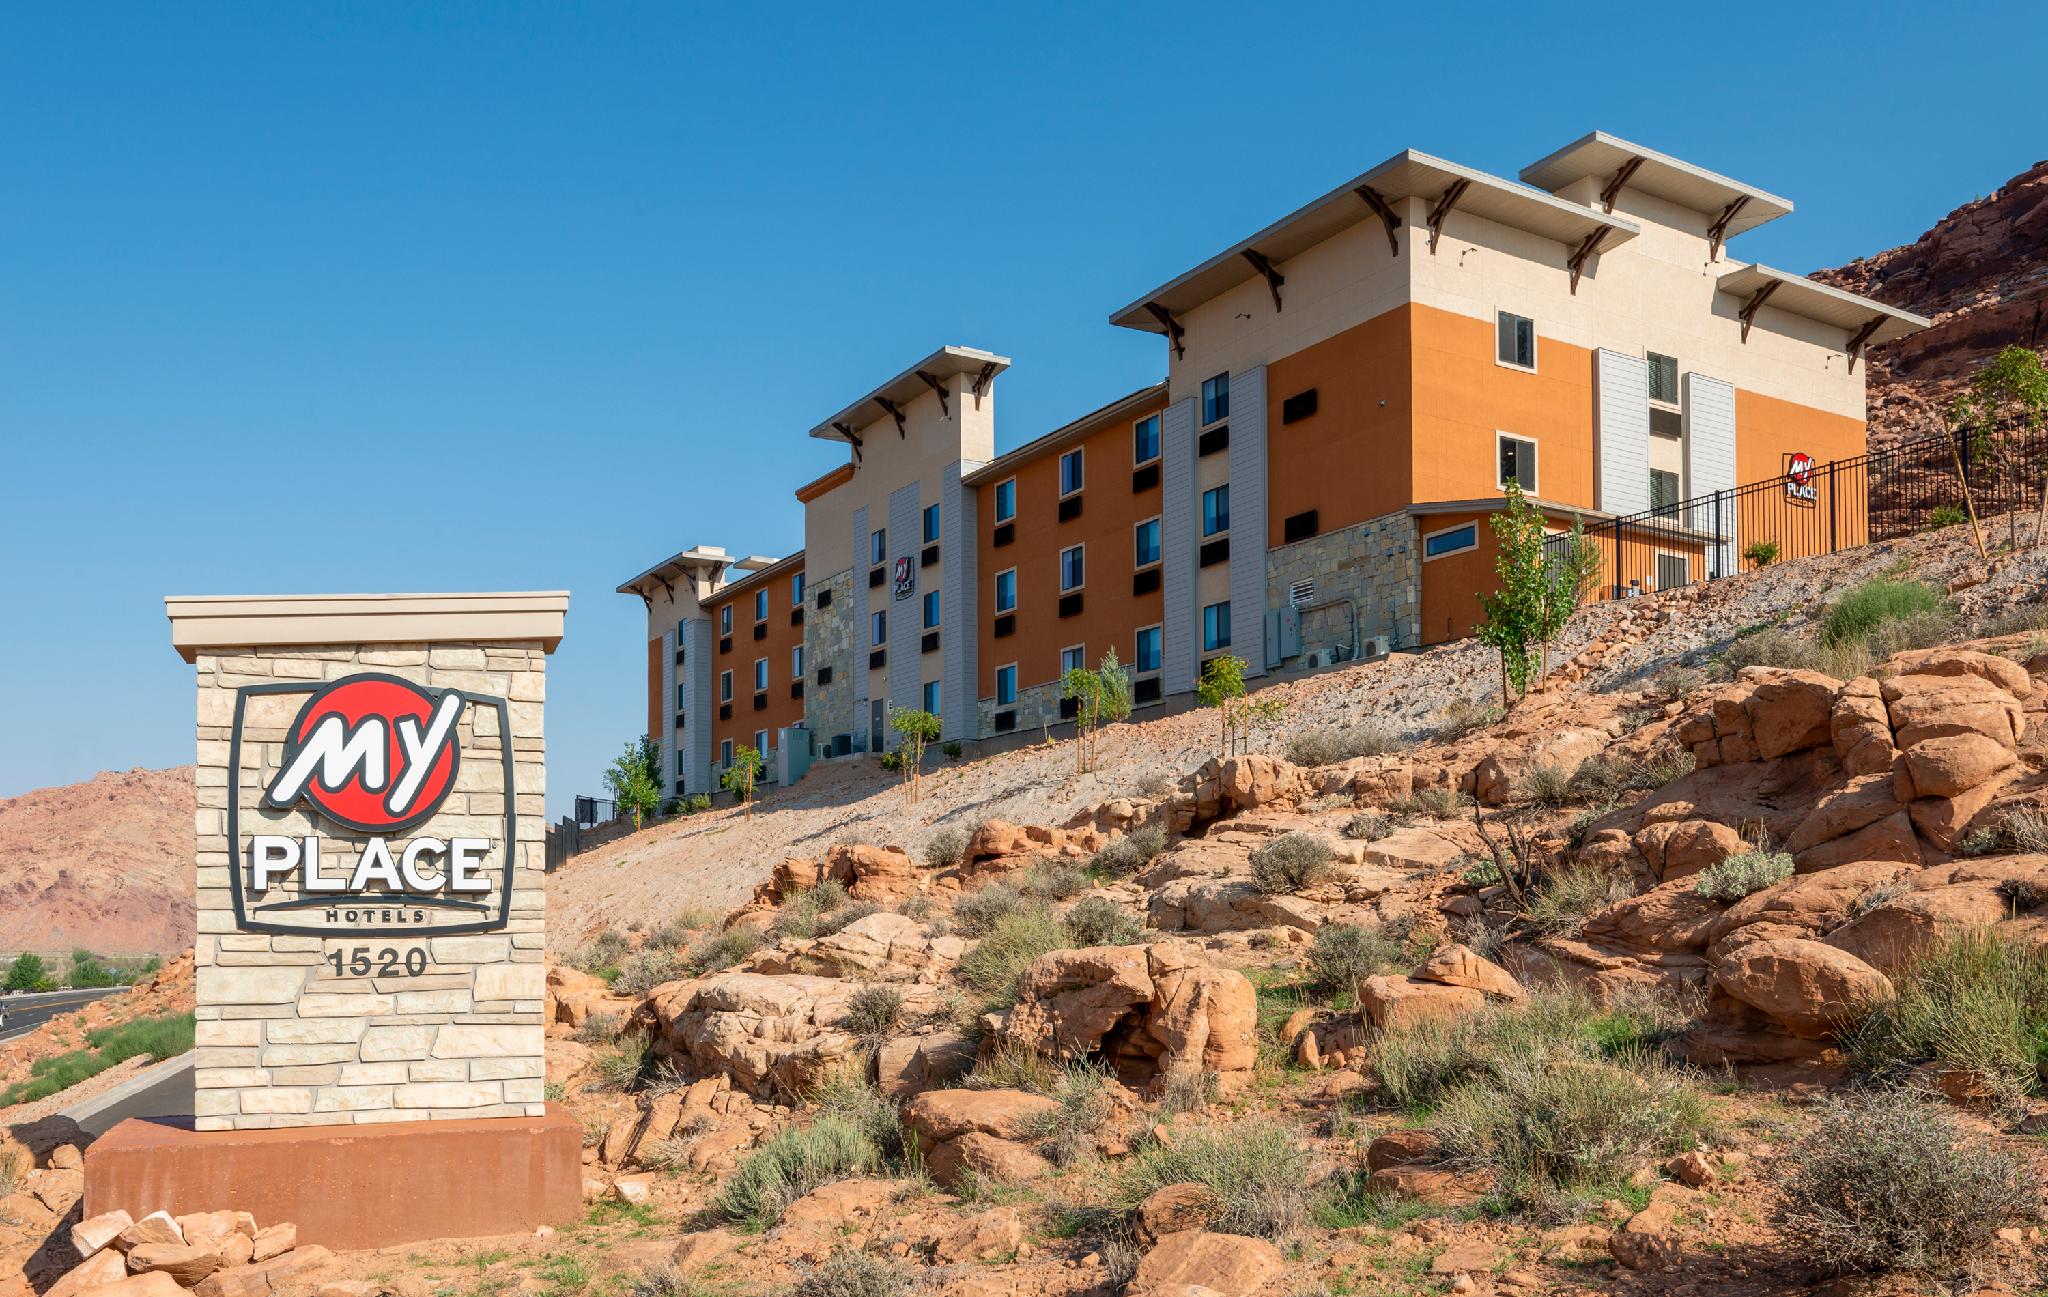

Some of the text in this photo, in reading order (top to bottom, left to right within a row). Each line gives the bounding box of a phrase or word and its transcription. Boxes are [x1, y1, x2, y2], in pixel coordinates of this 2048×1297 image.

[1787, 483, 1816, 500] PLACE
[252, 835, 493, 893] PLACE
[325, 909, 425, 924] HOTELS
[327, 946, 427, 978] 1520
